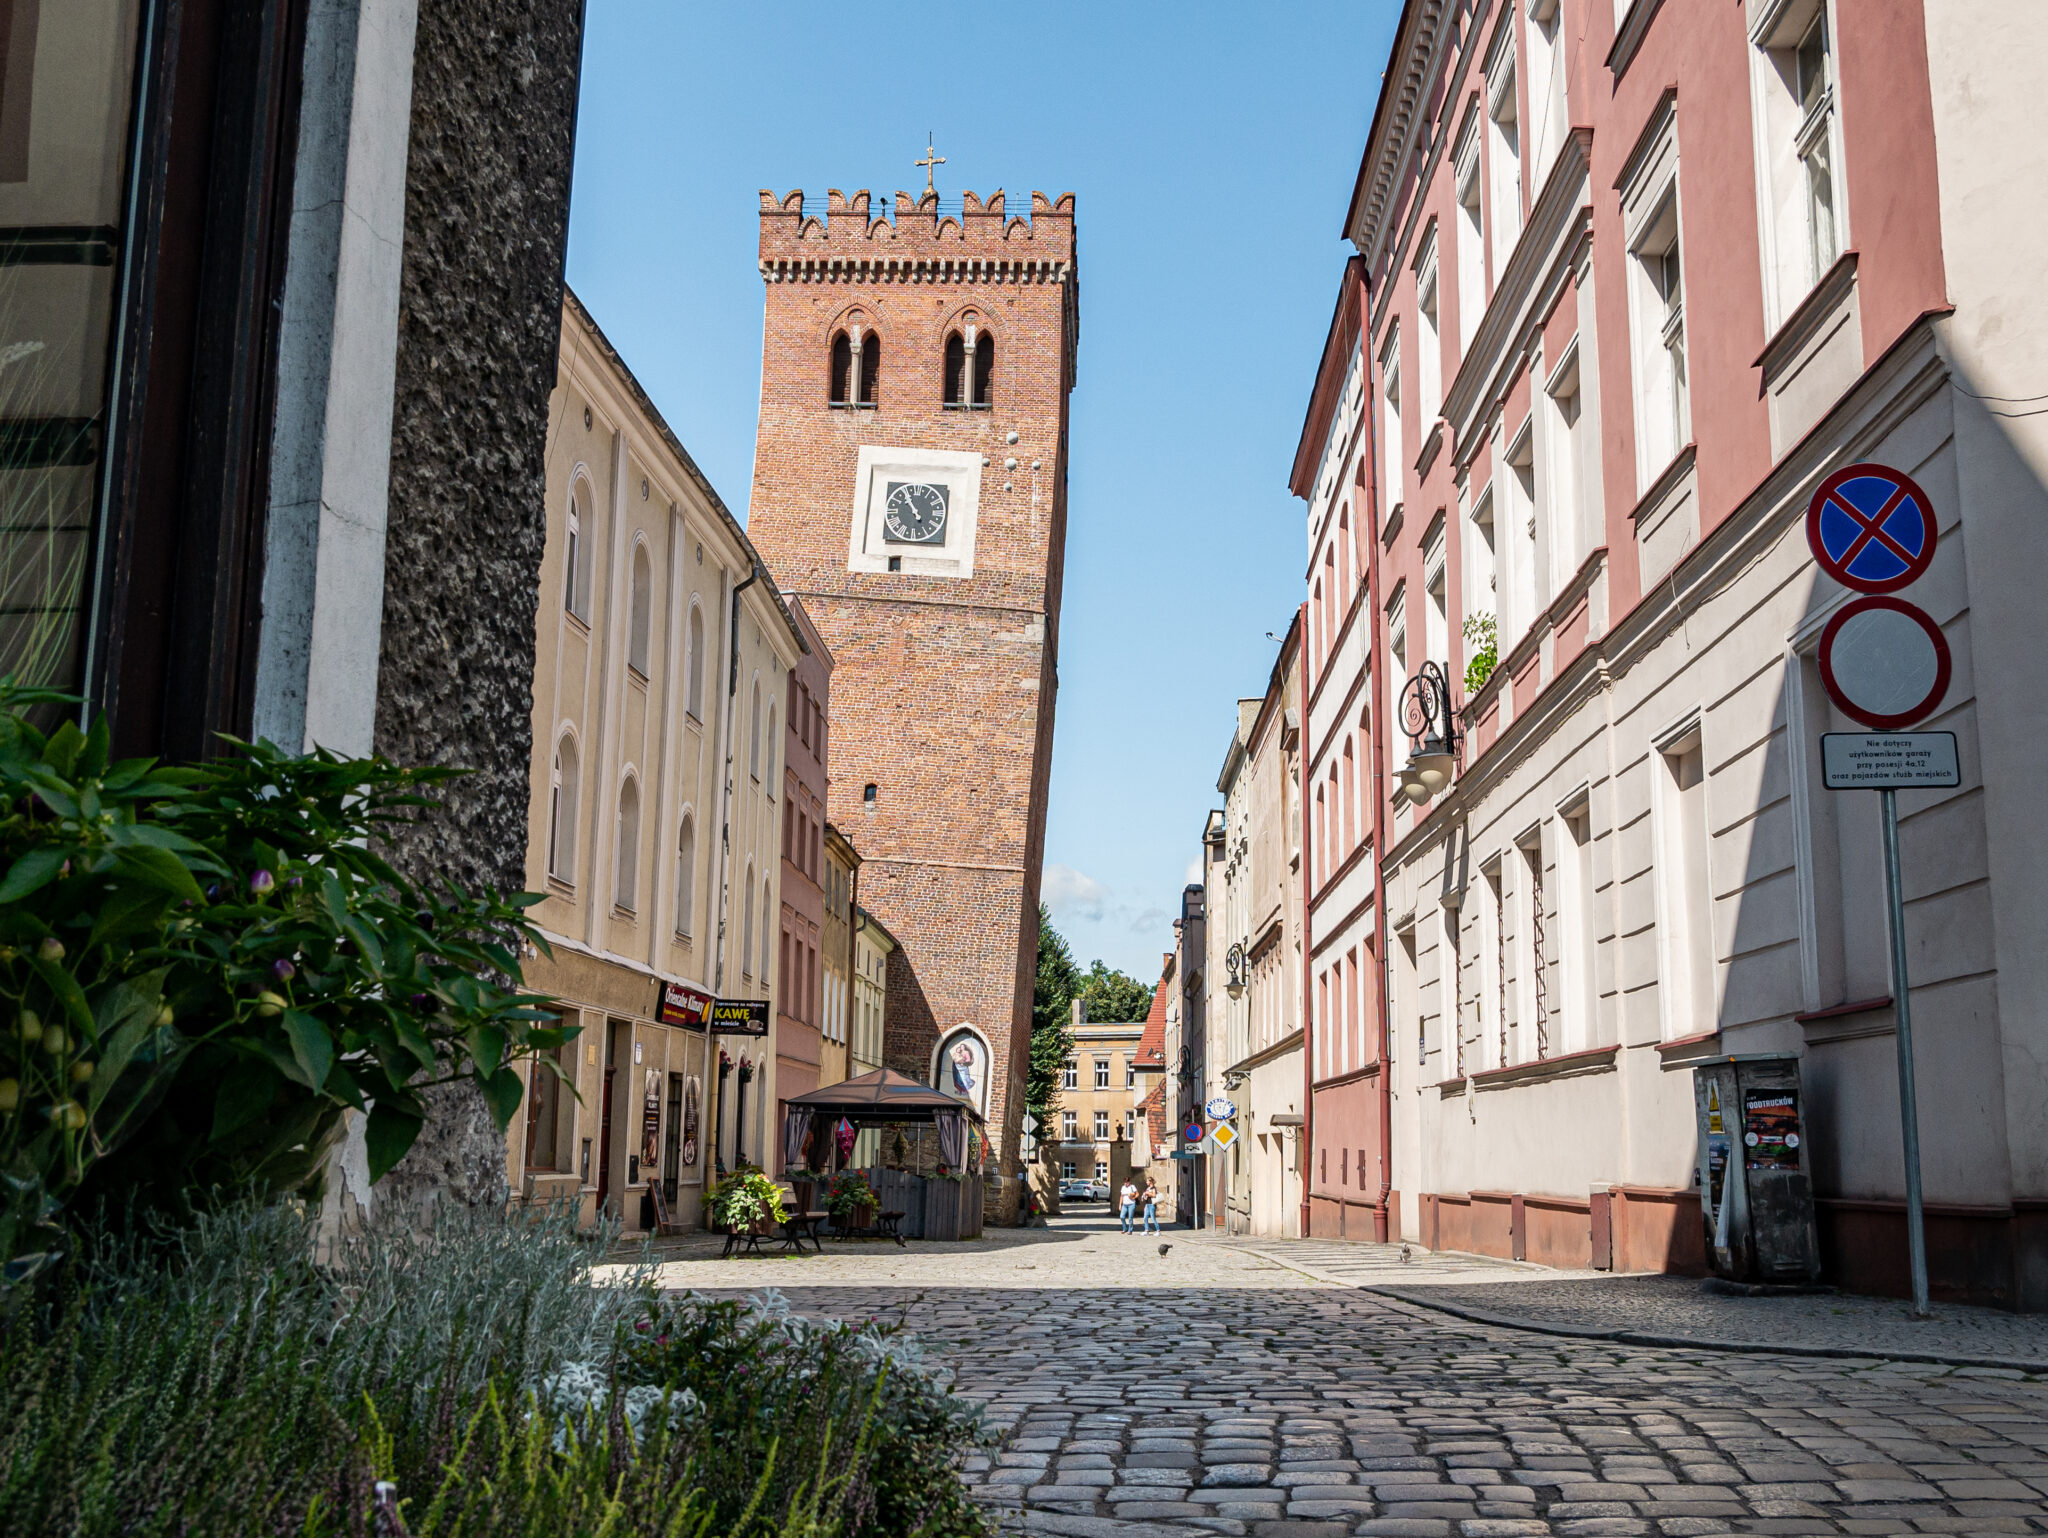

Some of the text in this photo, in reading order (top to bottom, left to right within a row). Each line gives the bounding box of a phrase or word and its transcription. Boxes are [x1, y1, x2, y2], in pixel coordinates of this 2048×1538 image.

[1883, 740, 1912, 748] dotyczy
[1848, 750, 1931, 760] użytkowników garaży
[1856, 761, 1872, 769] przy
[1875, 760, 1902, 770] posesji
[1852, 771, 1890, 781] pojazdów
[1892, 770, 1913, 778] służb
[1915, 769, 1952, 780] miejskich
[714, 1007, 751, 1023] KAWĘ
